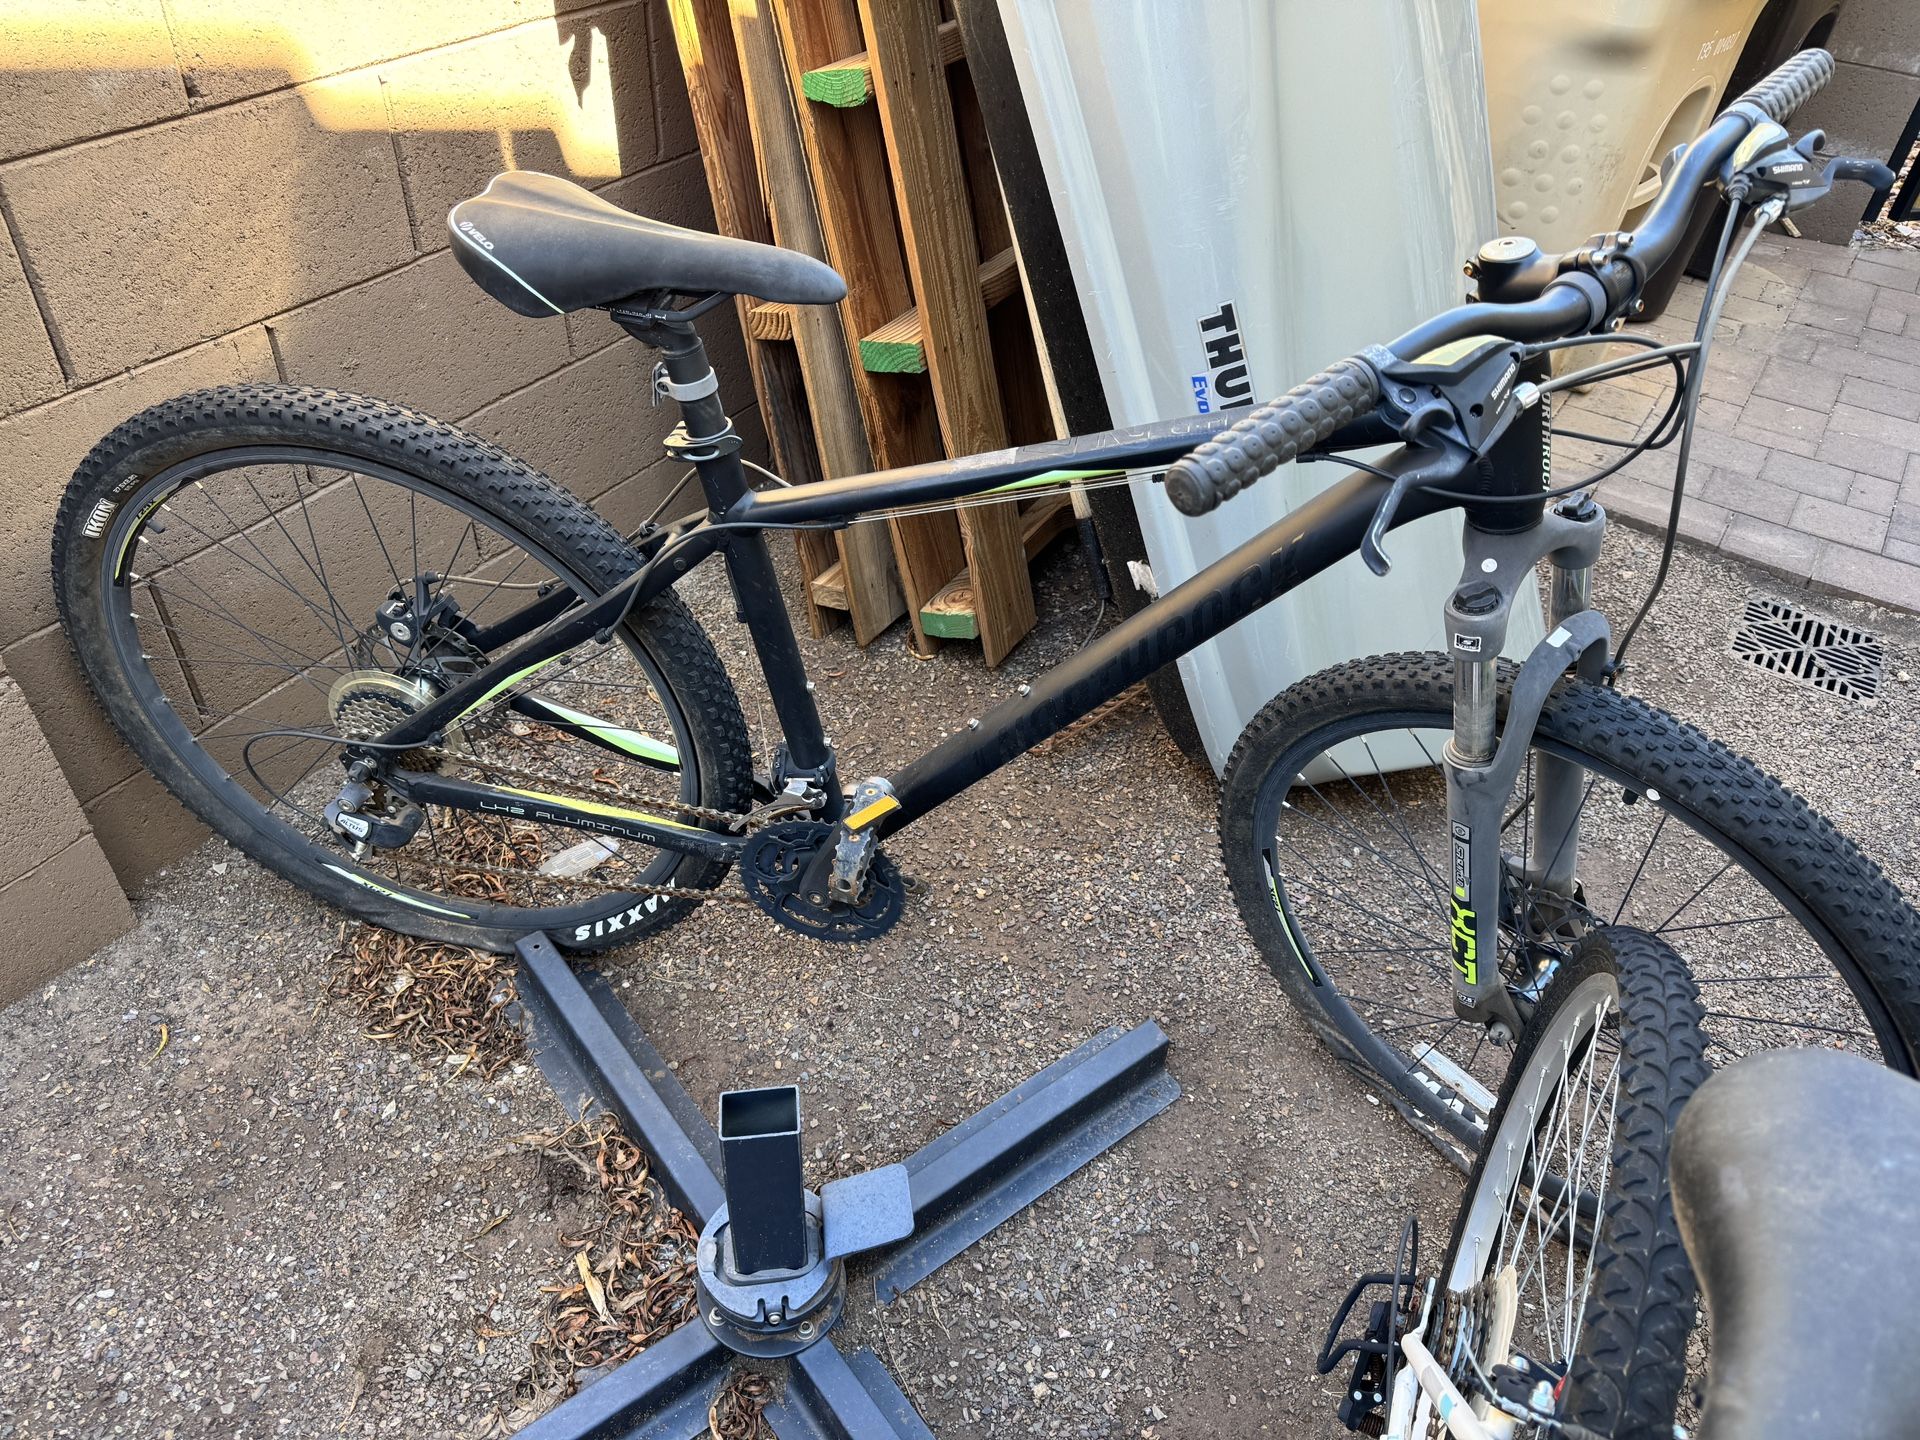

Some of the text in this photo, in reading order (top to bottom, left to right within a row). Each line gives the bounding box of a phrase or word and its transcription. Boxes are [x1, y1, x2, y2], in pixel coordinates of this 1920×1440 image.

[1772, 163, 1804, 175] SHIMANO
[467, 228, 495, 250] VELO
[1200, 303, 1254, 410] THU
[1491, 362, 1516, 400] SHIMANO
[82, 498, 119, 538] IKON
[340, 818, 363, 834] ALTUS
[535, 811, 656, 842] ALUMINUM
[1450, 897, 1477, 985] XCT
